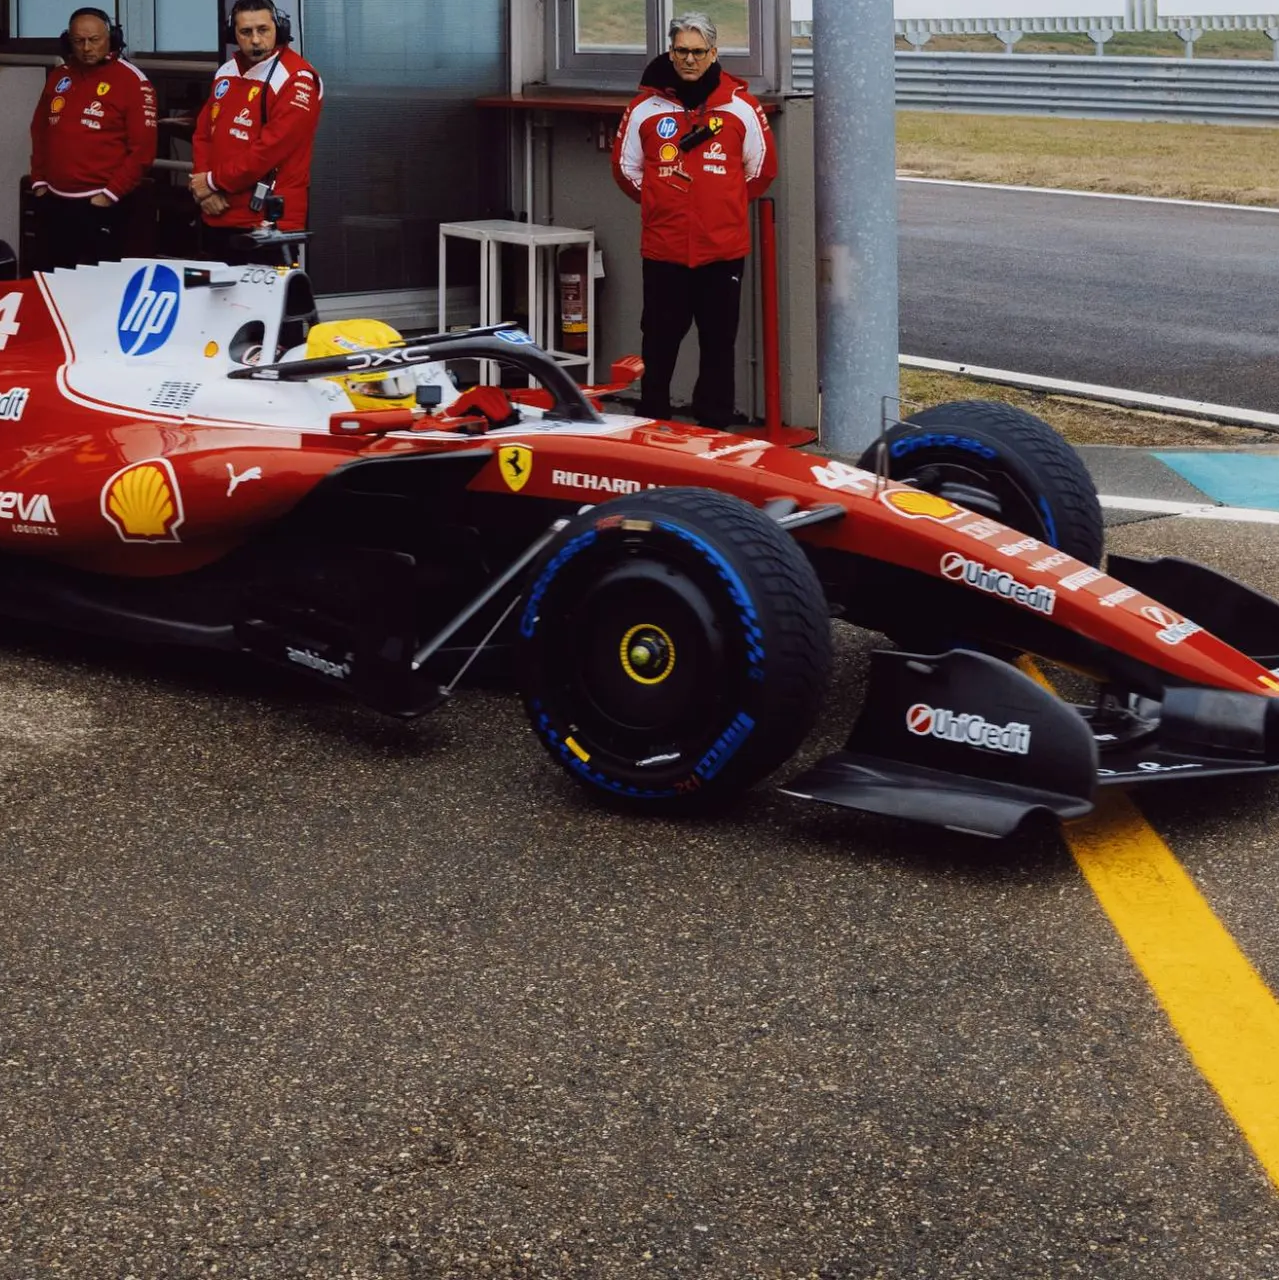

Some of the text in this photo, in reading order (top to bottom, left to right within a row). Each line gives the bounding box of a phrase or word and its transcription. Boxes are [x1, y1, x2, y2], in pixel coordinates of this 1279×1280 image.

[659, 117, 677, 138] hp
[119, 263, 180, 357] hp
[552, 469, 641, 495] RICHARD
[965, 561, 1055, 614] UniCredit
[932, 708, 1032, 754] UniCredit
